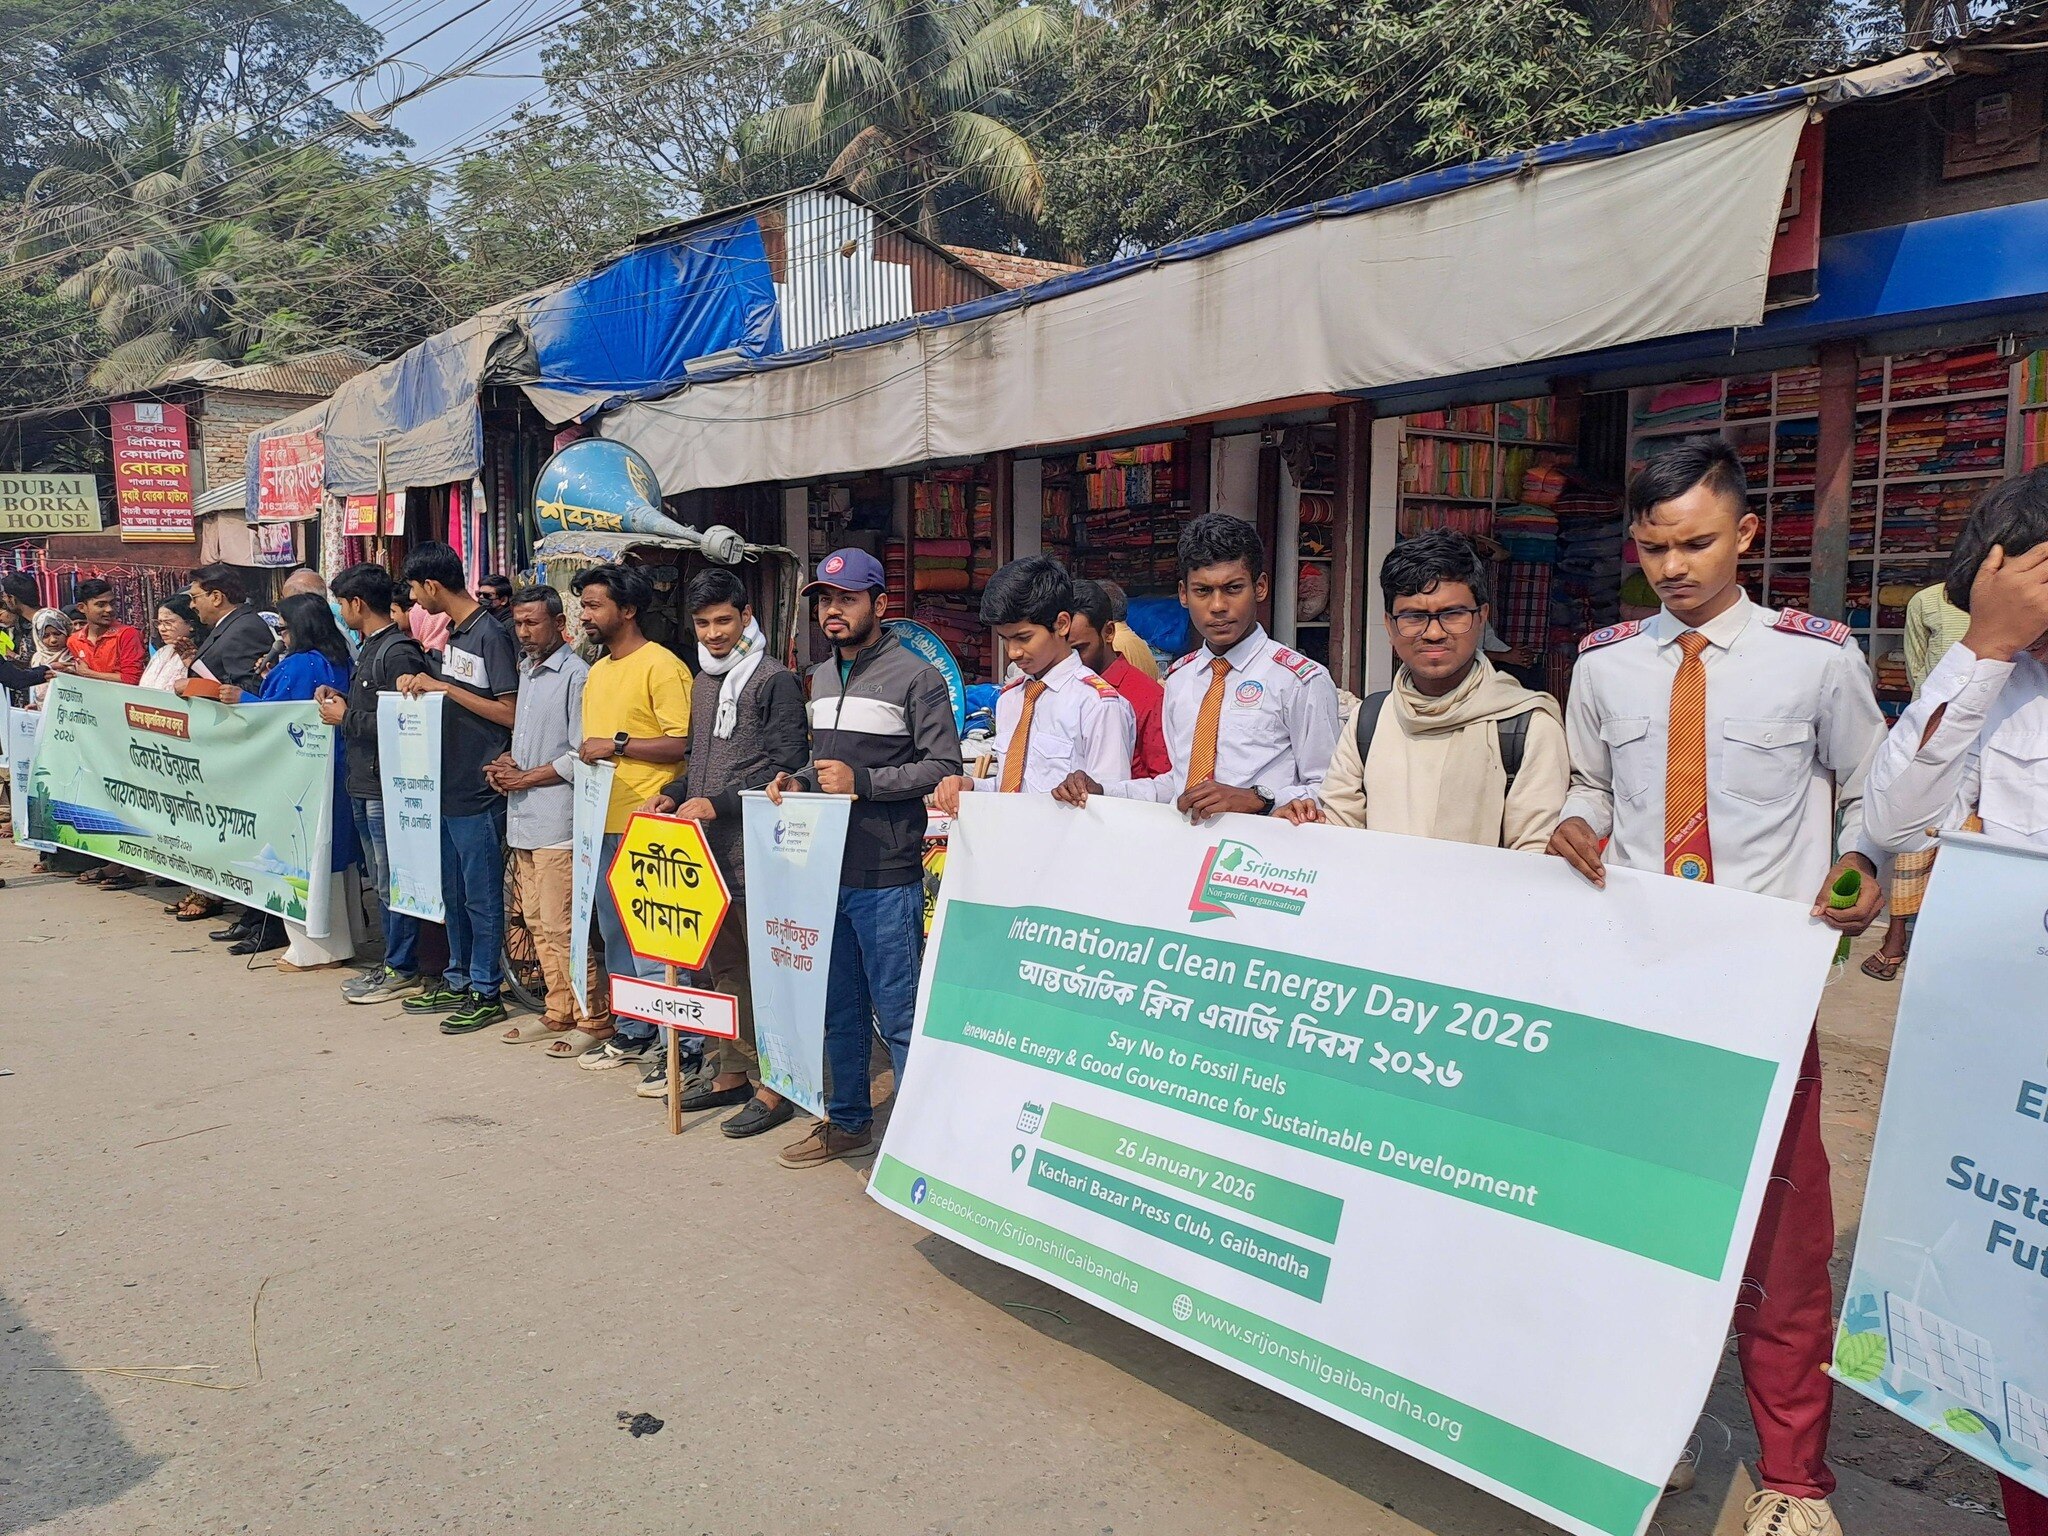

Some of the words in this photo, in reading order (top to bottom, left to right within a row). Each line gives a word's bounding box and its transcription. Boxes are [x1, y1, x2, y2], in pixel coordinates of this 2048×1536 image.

[120, 449, 186, 460] কোয়ালিটি
[127, 436, 181, 448] প্রিমিয়াম
[121, 462, 188, 477] বোরকা
[2, 480, 82, 495] DUBAI
[3, 497, 89, 511] BORKA
[121, 488, 140, 504] দুবাই
[142, 490, 165, 502] বোরকা
[7, 513, 90, 528] HOUSE
[129, 737, 165, 777] টেকসই
[407, 775, 434, 791] আগামীর
[160, 790, 205, 826] জ্বালানি
[206, 804, 216, 827] ও
[216, 804, 257, 843] সুশাসন
[628, 843, 703, 892] দুর্নীতি
[1244, 860, 1318, 884] Srijonshil
[1208, 886, 1248, 901] Non-profit
[1249, 896, 1302, 912] organisation
[1211, 872, 1309, 899] GAIBANDHA
[631, 896, 703, 942] থামান
[793, 954, 813, 972] খাত
[1008, 915, 1154, 965] International
[1157, 942, 1236, 985] Clean
[1243, 958, 1357, 1017] Energy
[1364, 983, 1439, 1035] Day
[1445, 1002, 1552, 1053] 2026
[634, 997, 704, 1025] ...এখনই
[1018, 960, 1138, 1006] আন্তর্জাতিক
[1139, 979, 1194, 1022] ক্লিন
[1198, 1002, 1283, 1043] এনার্জি
[1286, 1013, 1364, 1063] দিবস
[1368, 1041, 1464, 1088] ২০২৬
[1107, 1030, 1136, 1056] Say
[1139, 1038, 1164, 1060] No
[1168, 1047, 1187, 1067] to
[1191, 1053, 1239, 1083] Fossil
[1241, 1066, 1287, 1095] Fuels
[2015, 1079, 2048, 1123] E
[1020, 1037, 1064, 1065] Energy
[1066, 1049, 1077, 1067] &
[1080, 1053, 1124, 1080] Good
[1126, 1066, 1229, 1113] Governance
[1232, 1097, 1259, 1122] for
[1261, 1106, 1373, 1156] Sustainable
[1378, 1140, 1538, 1207] Development
[1115, 1137, 1138, 1158] 26
[1138, 1145, 1209, 1188] January
[1211, 1171, 1257, 1201] 2026
[1037, 1159, 1088, 1192] Kachari
[1089, 1179, 1129, 1208] Bazar
[1131, 1196, 1171, 1225] Press
[1174, 1213, 1215, 1245] Club,
[1220, 1230, 1309, 1279] Gaibandha
[926, 1188, 1140, 1294] facebook.com/SrijonshilGaibandha
[1196, 1306, 1464, 1442] www.srijonshilgaibandha.org
